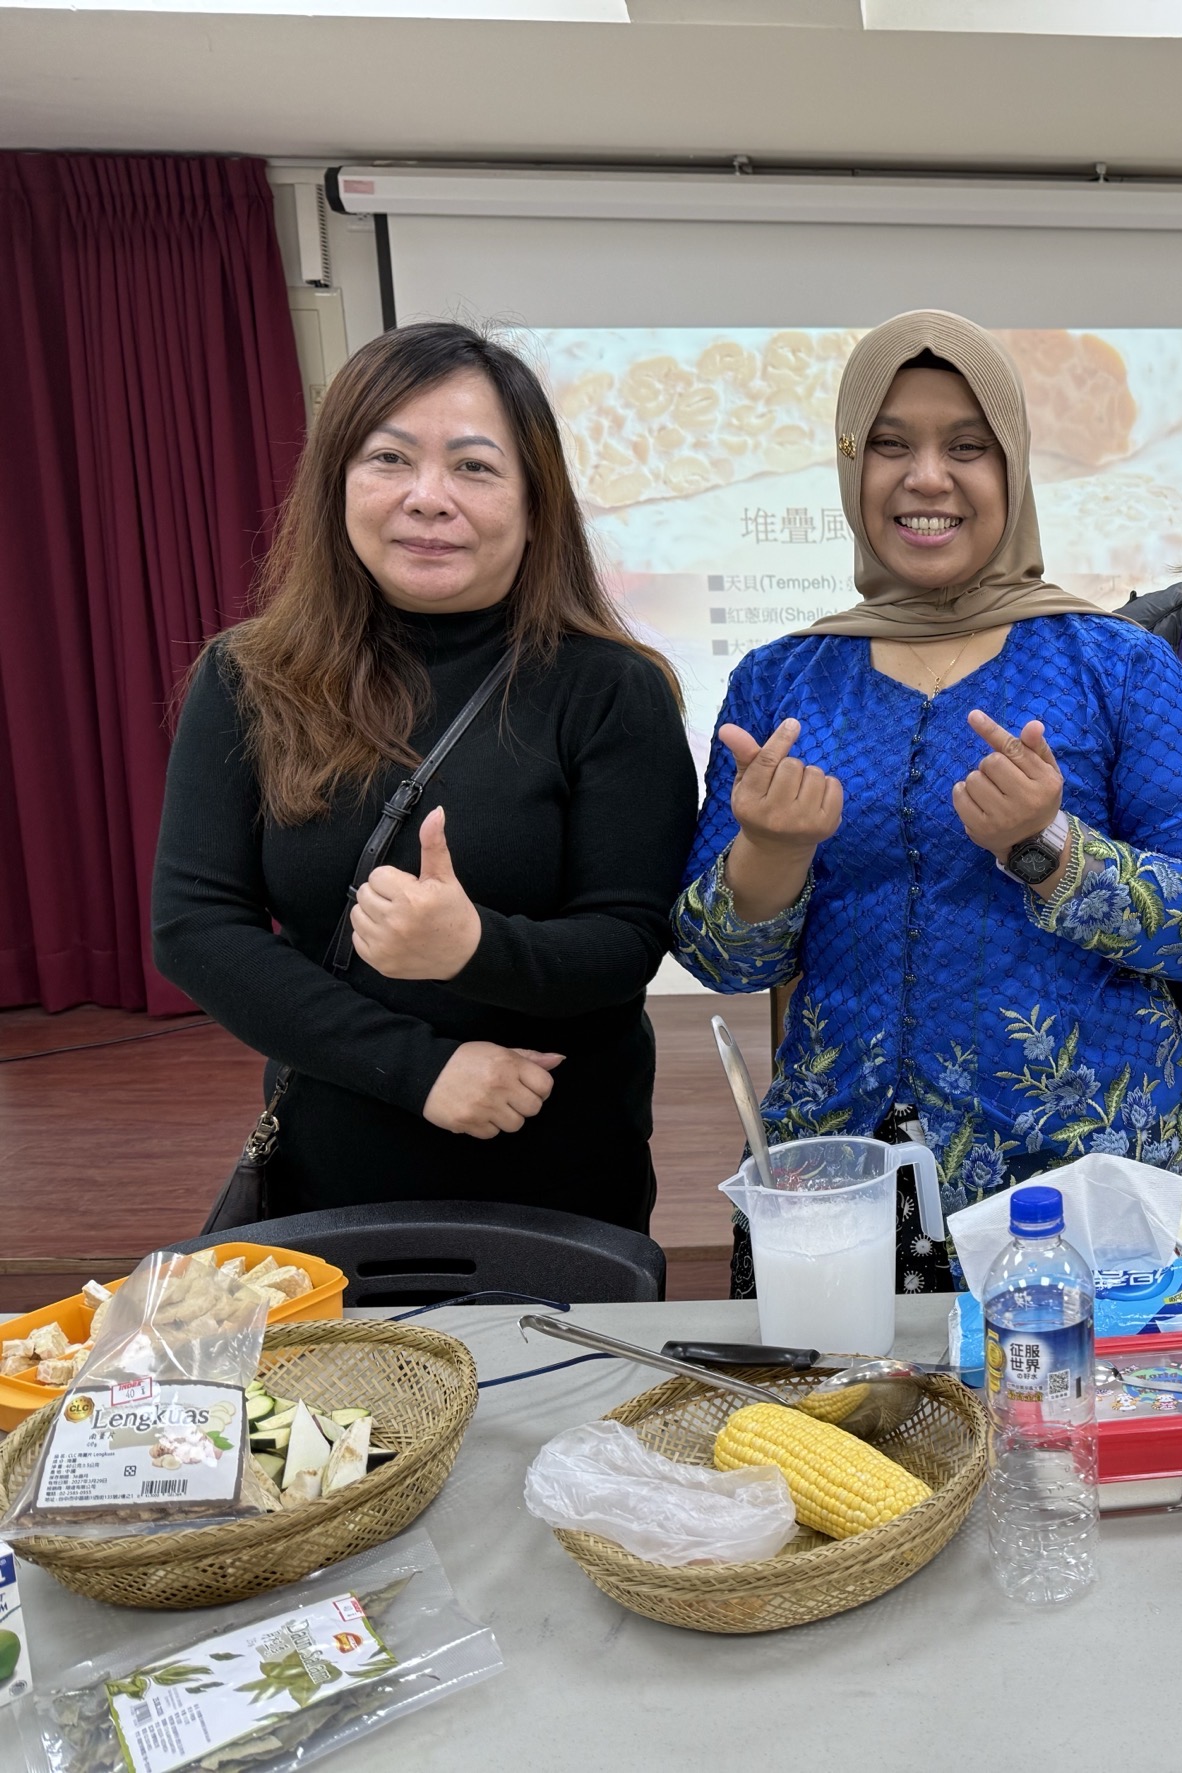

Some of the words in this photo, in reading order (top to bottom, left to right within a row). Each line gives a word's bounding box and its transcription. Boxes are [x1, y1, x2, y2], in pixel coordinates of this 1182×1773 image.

[1009, 1343, 1040, 1359] 征服
[1010, 1357, 1040, 1373] 世界
[69, 1404, 90, 1412] CLC
[91, 1403, 210, 1433] Lengkuas
[286, 1619, 313, 1650] Daun
[300, 1649, 332, 1685] Salam
